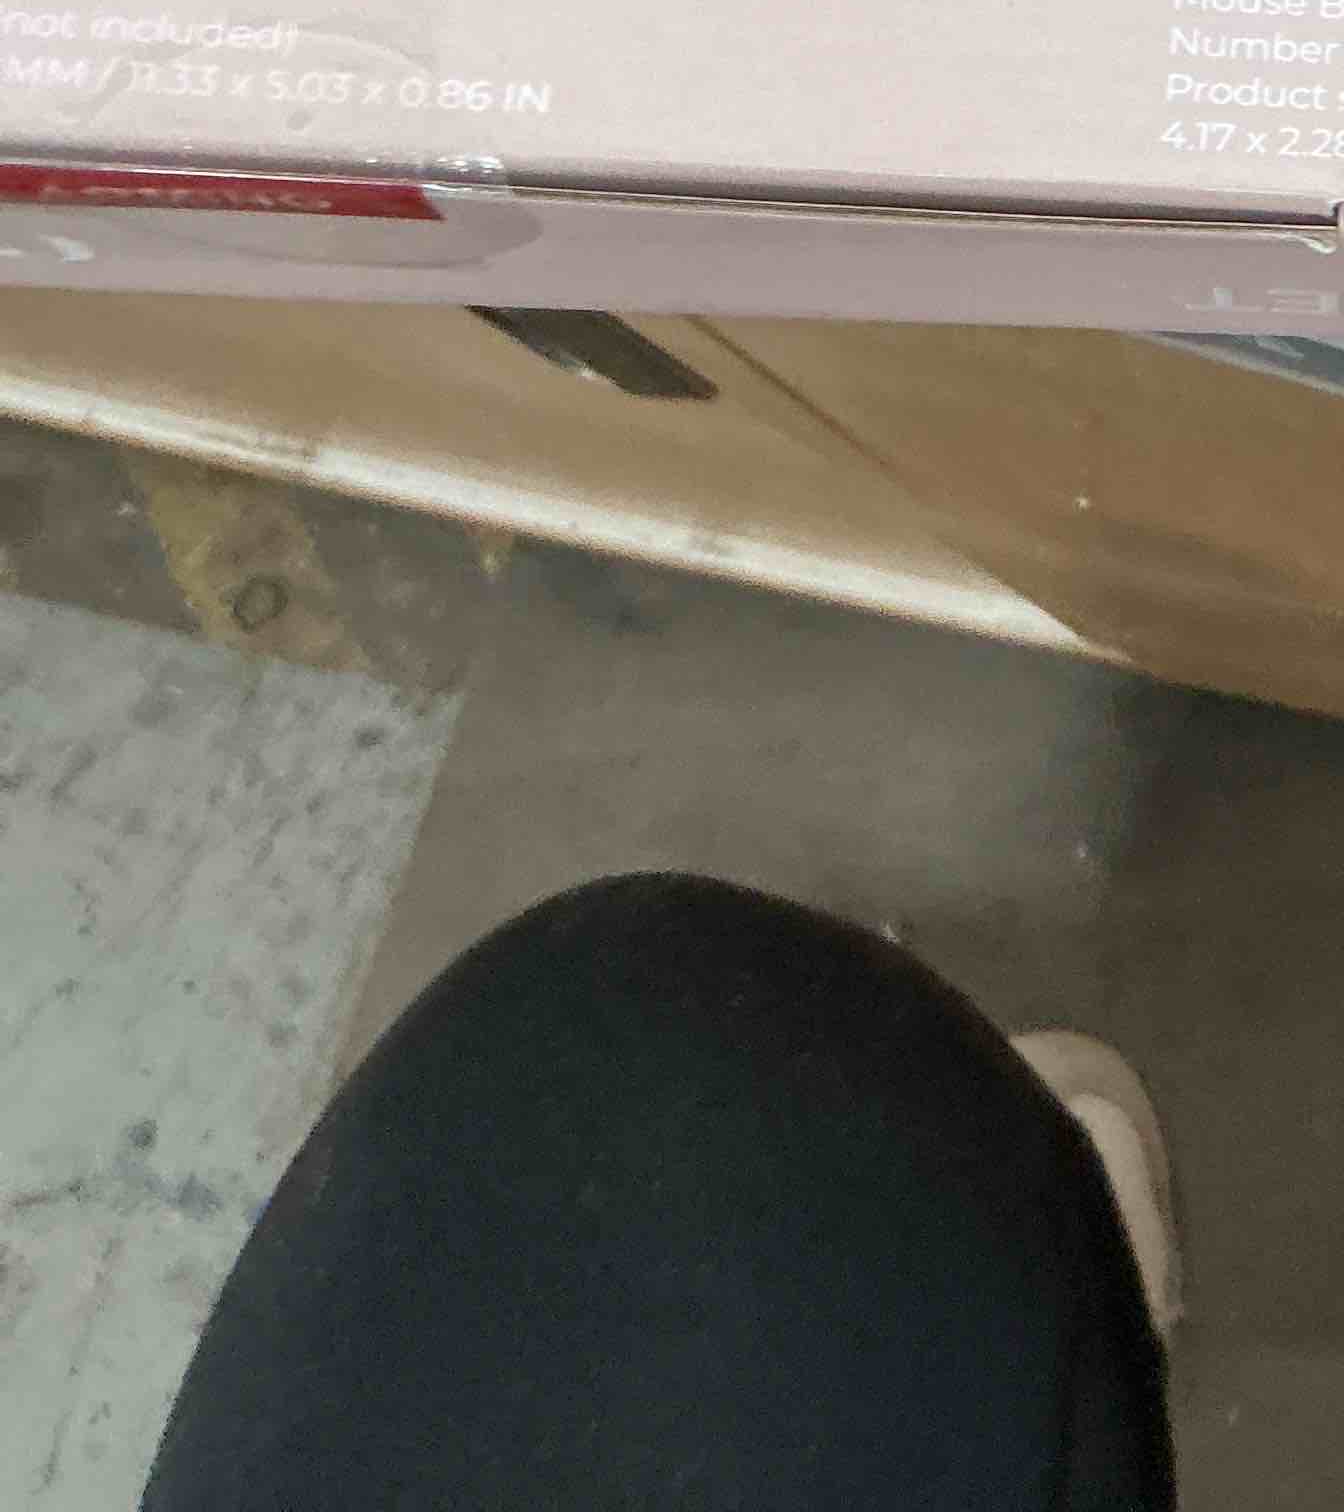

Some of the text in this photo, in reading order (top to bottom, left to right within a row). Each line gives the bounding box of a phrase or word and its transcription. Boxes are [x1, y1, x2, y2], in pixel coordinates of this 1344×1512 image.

[90, 10, 300, 57] included)
[1169, 26, 1340, 68] Number
[402, 76, 552, 114] 0.86 IN
[1164, 72, 1328, 113] Product
[1160, 119, 1236, 156] 4.17
